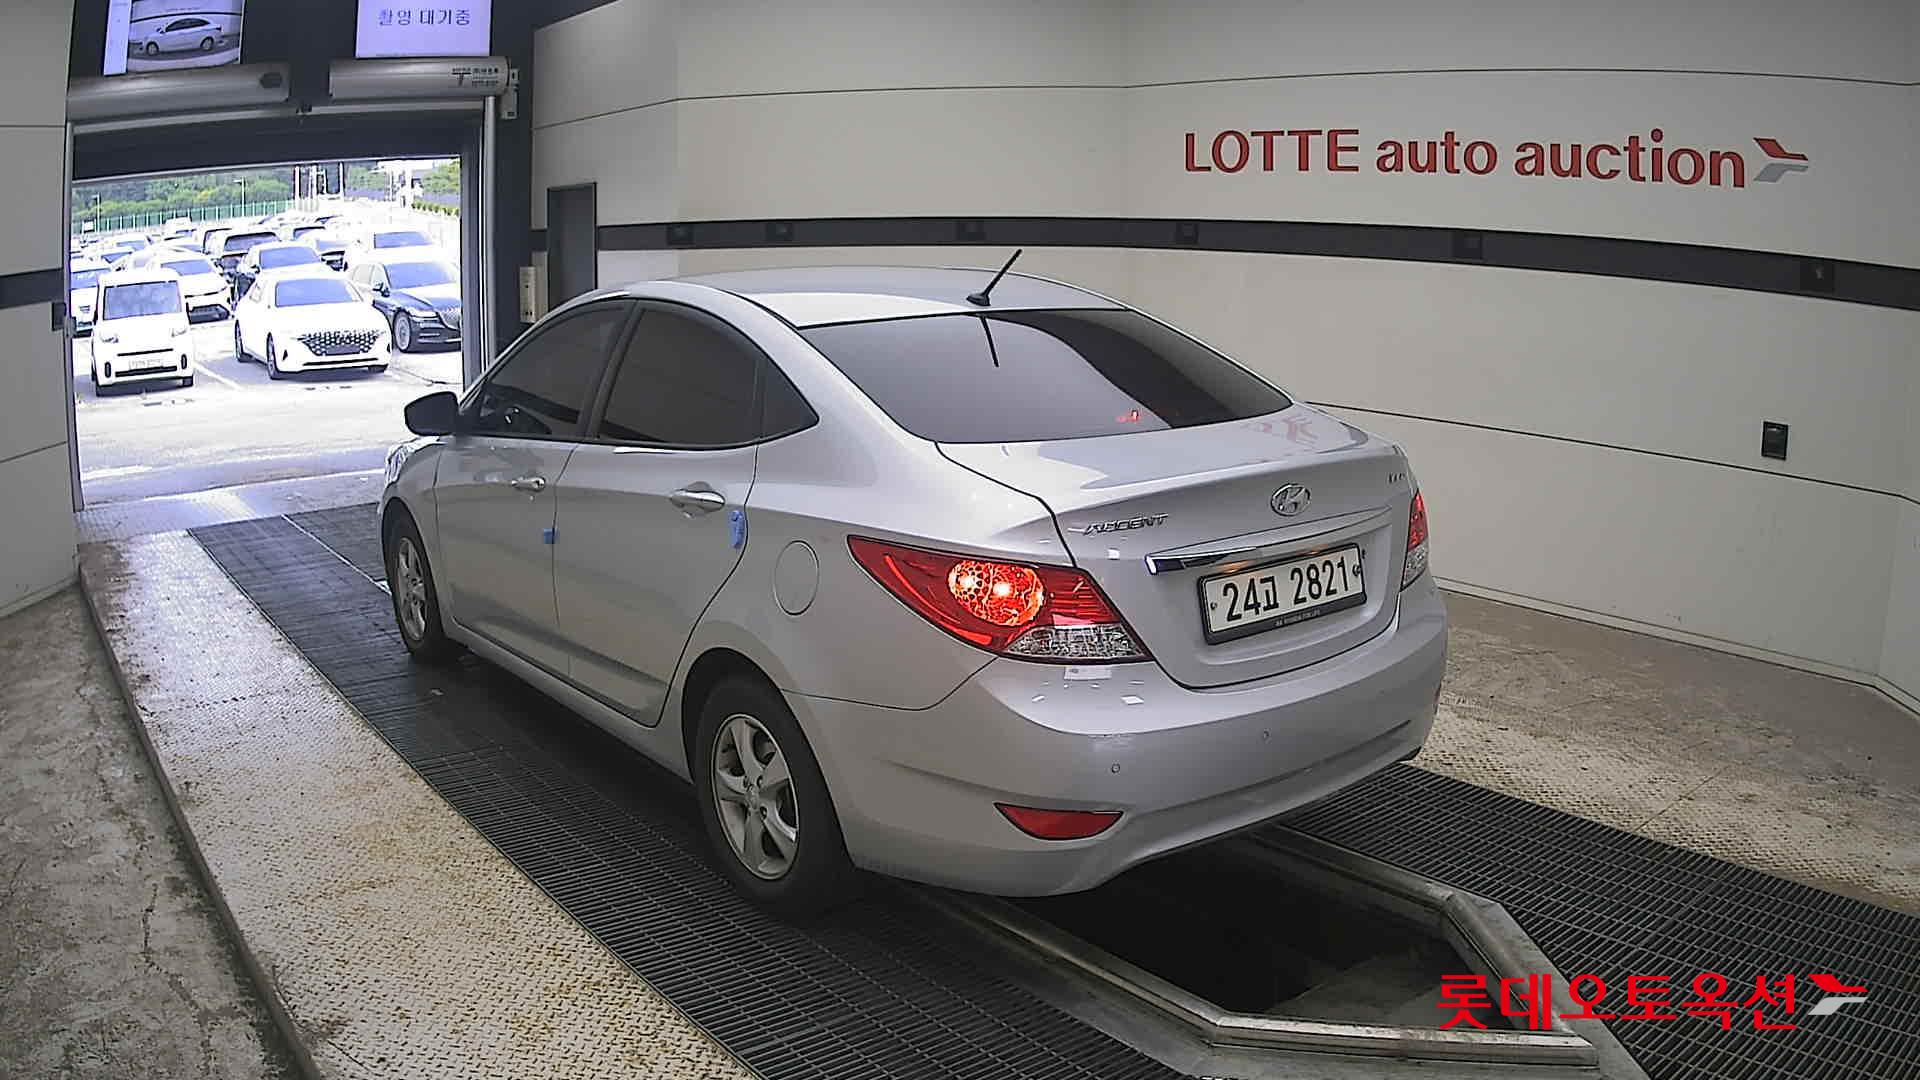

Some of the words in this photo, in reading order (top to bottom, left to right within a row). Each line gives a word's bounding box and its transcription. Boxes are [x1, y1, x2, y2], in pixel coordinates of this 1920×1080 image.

[420, 9, 470, 26] 대기중
[1184, 129, 1360, 174] LOTTE
[1376, 131, 1498, 175] auto
[1514, 128, 1745, 188] auction
[1070, 513, 1169, 536] ACCENT
[1222, 575, 1280, 622] 24고
[1290, 556, 1349, 605] 2821
